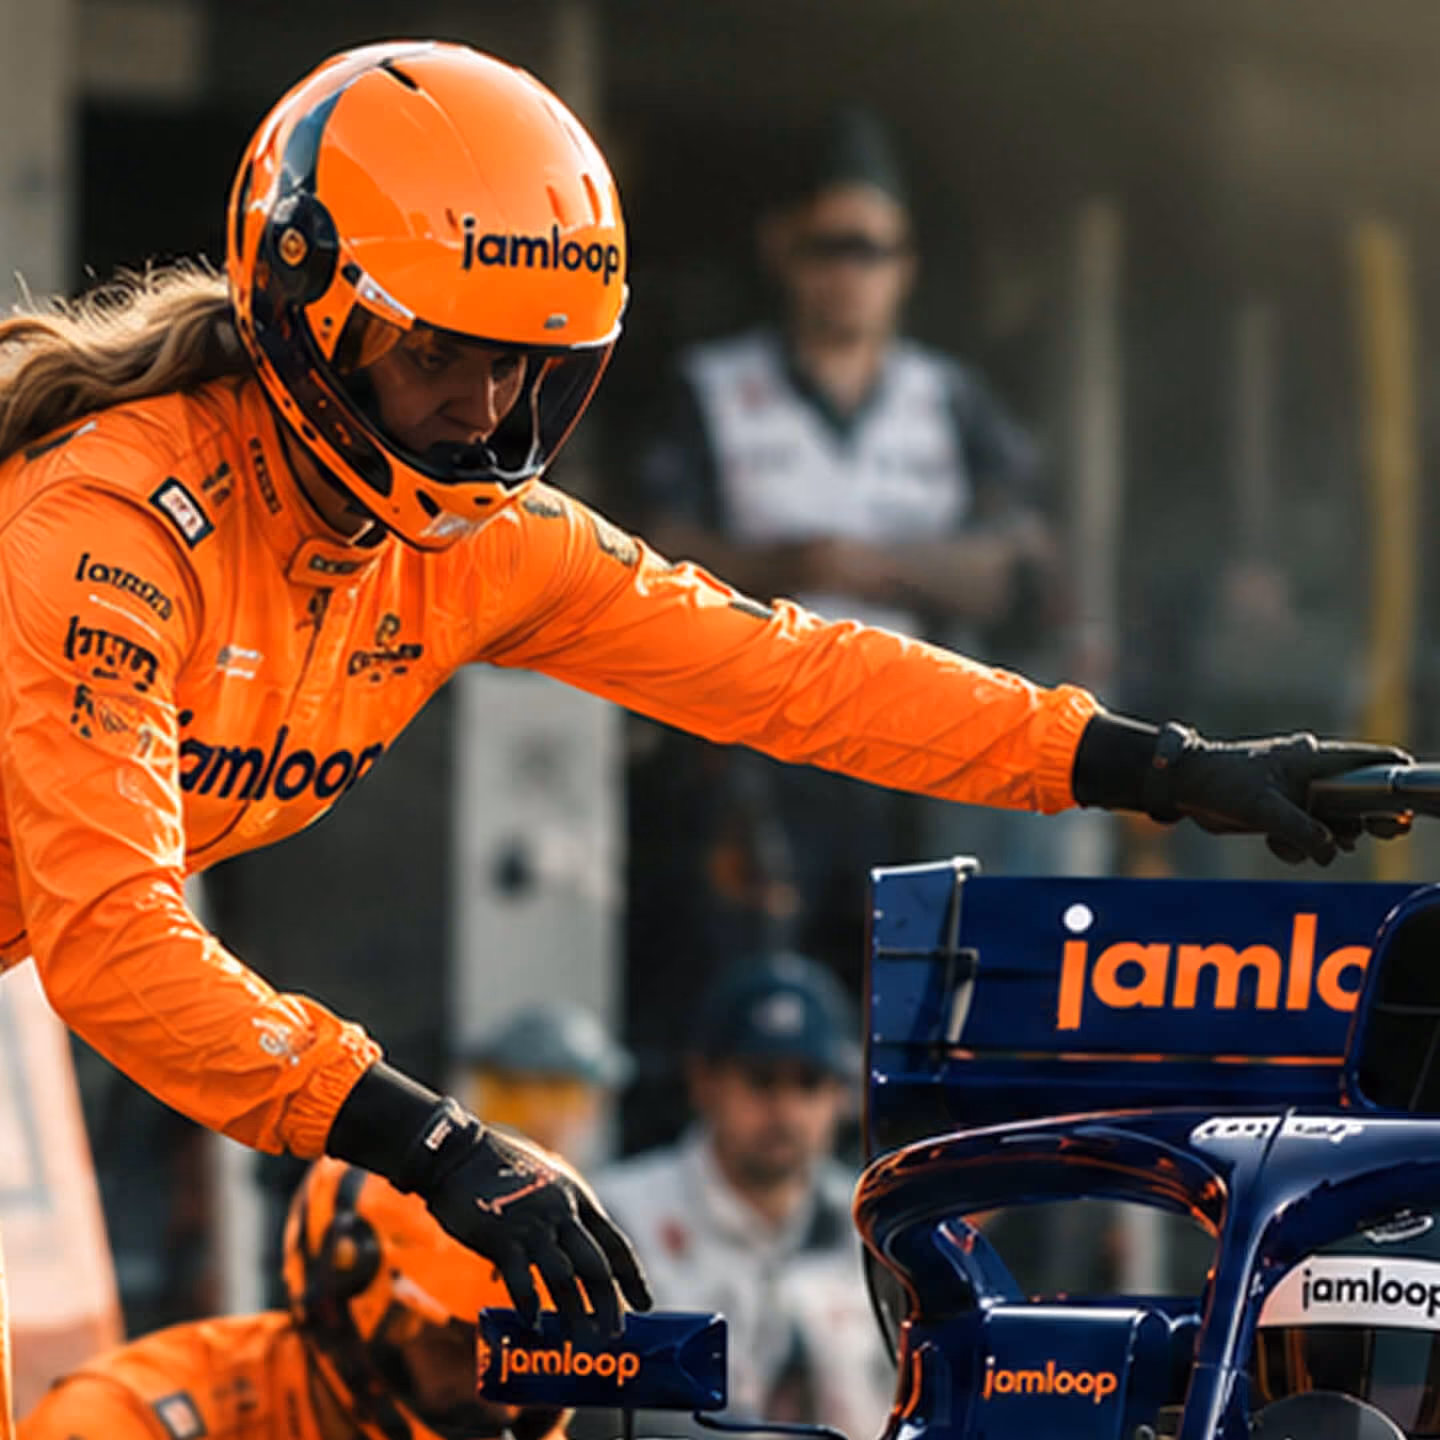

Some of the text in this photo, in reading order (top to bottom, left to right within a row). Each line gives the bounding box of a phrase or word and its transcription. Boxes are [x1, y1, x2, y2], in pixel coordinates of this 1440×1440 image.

[461, 216, 619, 286] jamloop
[500, 1335, 640, 1387] jamloop
[983, 1355, 1118, 1404] jamloop
